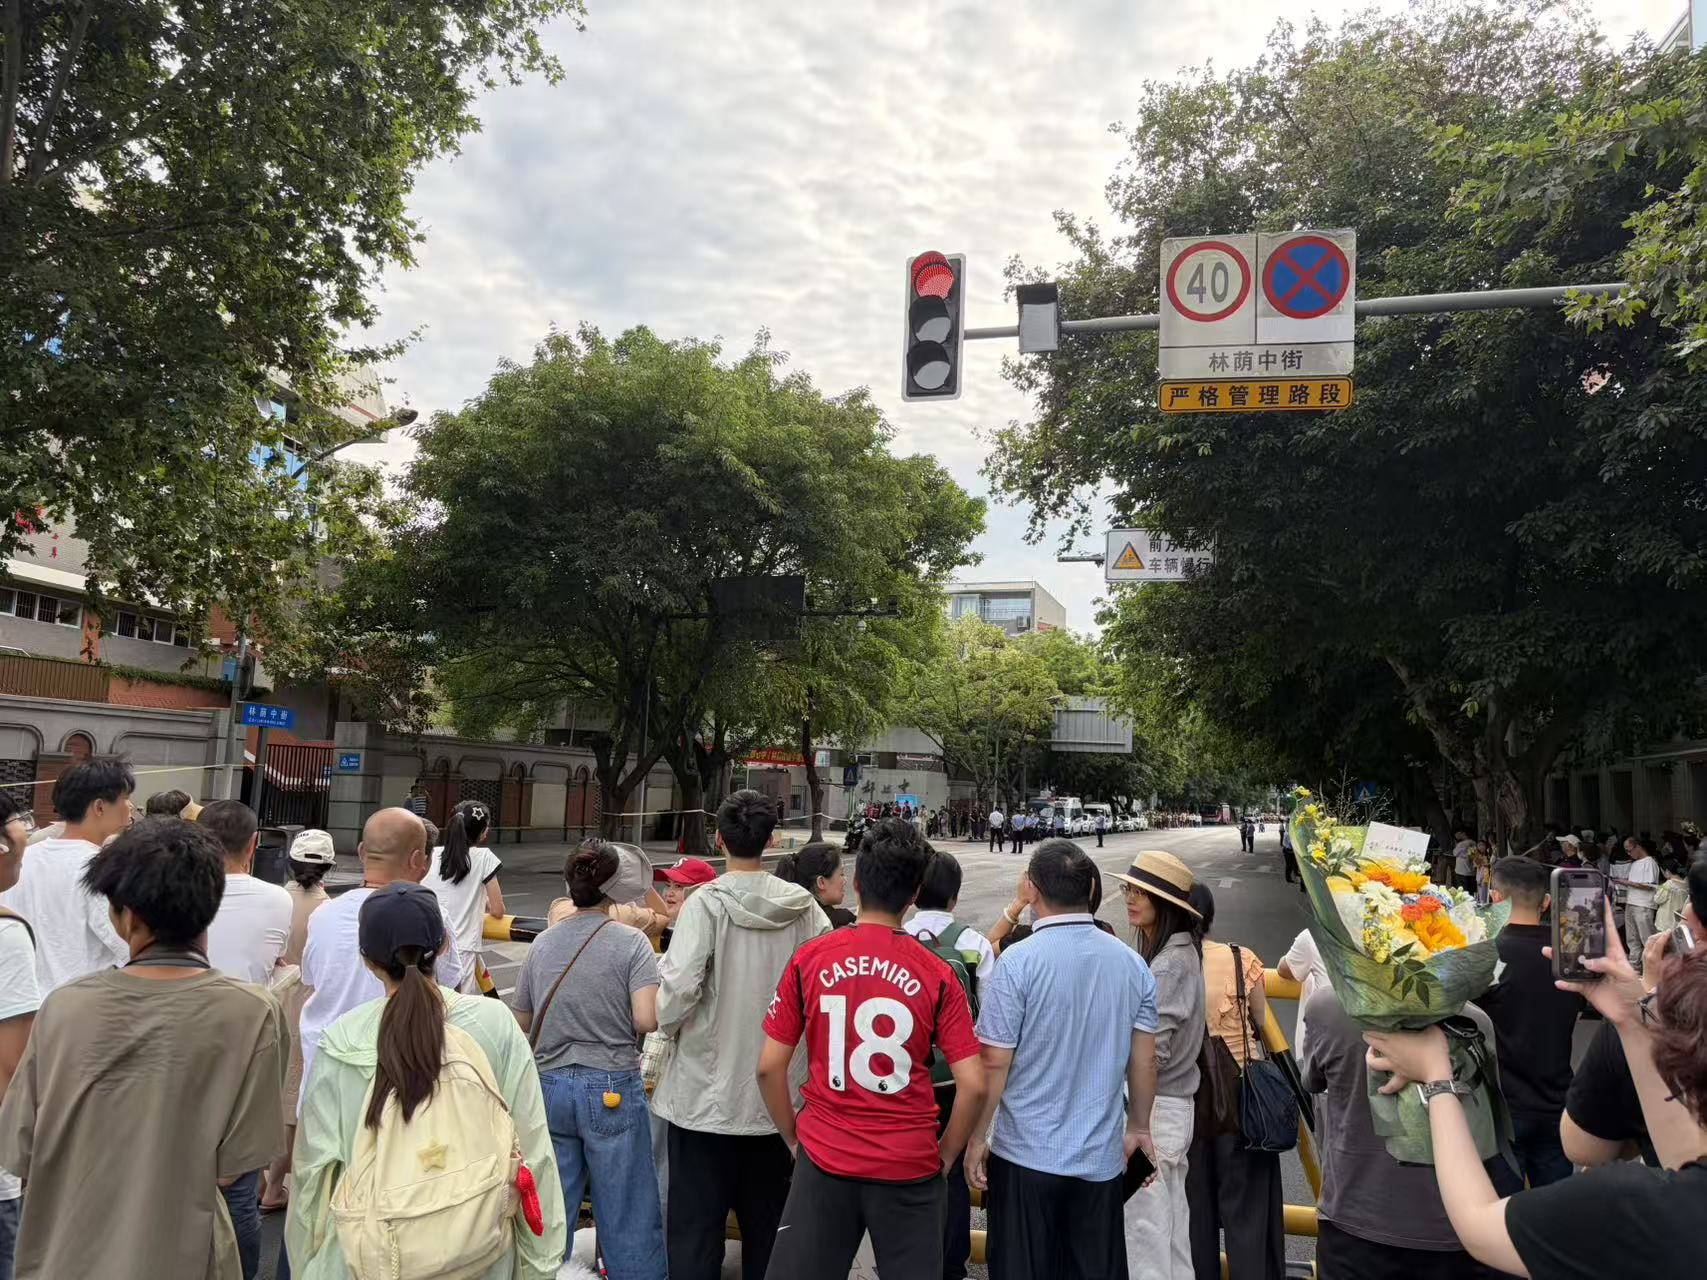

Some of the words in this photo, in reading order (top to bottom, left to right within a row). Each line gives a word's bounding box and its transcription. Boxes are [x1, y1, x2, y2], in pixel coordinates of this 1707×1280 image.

[1186, 261, 1230, 305] 40
[1208, 349, 1304, 373] 林荫中街
[1168, 383, 1341, 408] 严格管理路段
[819, 956, 921, 997] CASEMIRO
[819, 995, 914, 1095] 18
